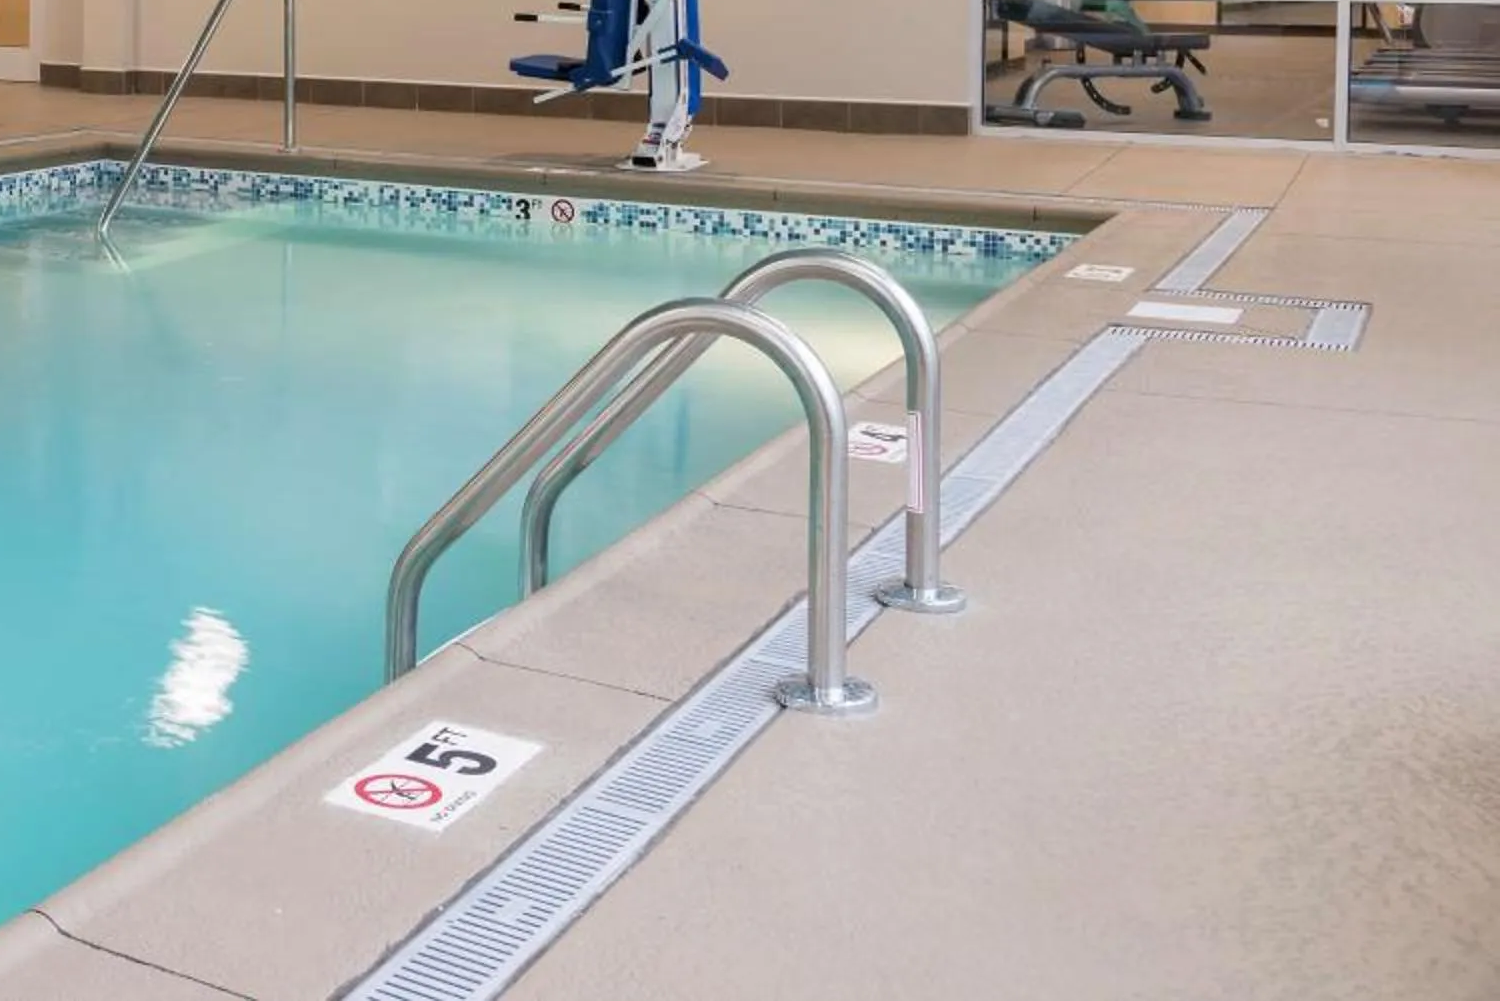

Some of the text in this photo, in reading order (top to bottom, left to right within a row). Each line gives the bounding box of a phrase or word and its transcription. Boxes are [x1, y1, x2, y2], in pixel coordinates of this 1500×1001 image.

[515, 198, 531, 220] 3
[431, 726, 468, 747] FT
[404, 742, 498, 776] 5
